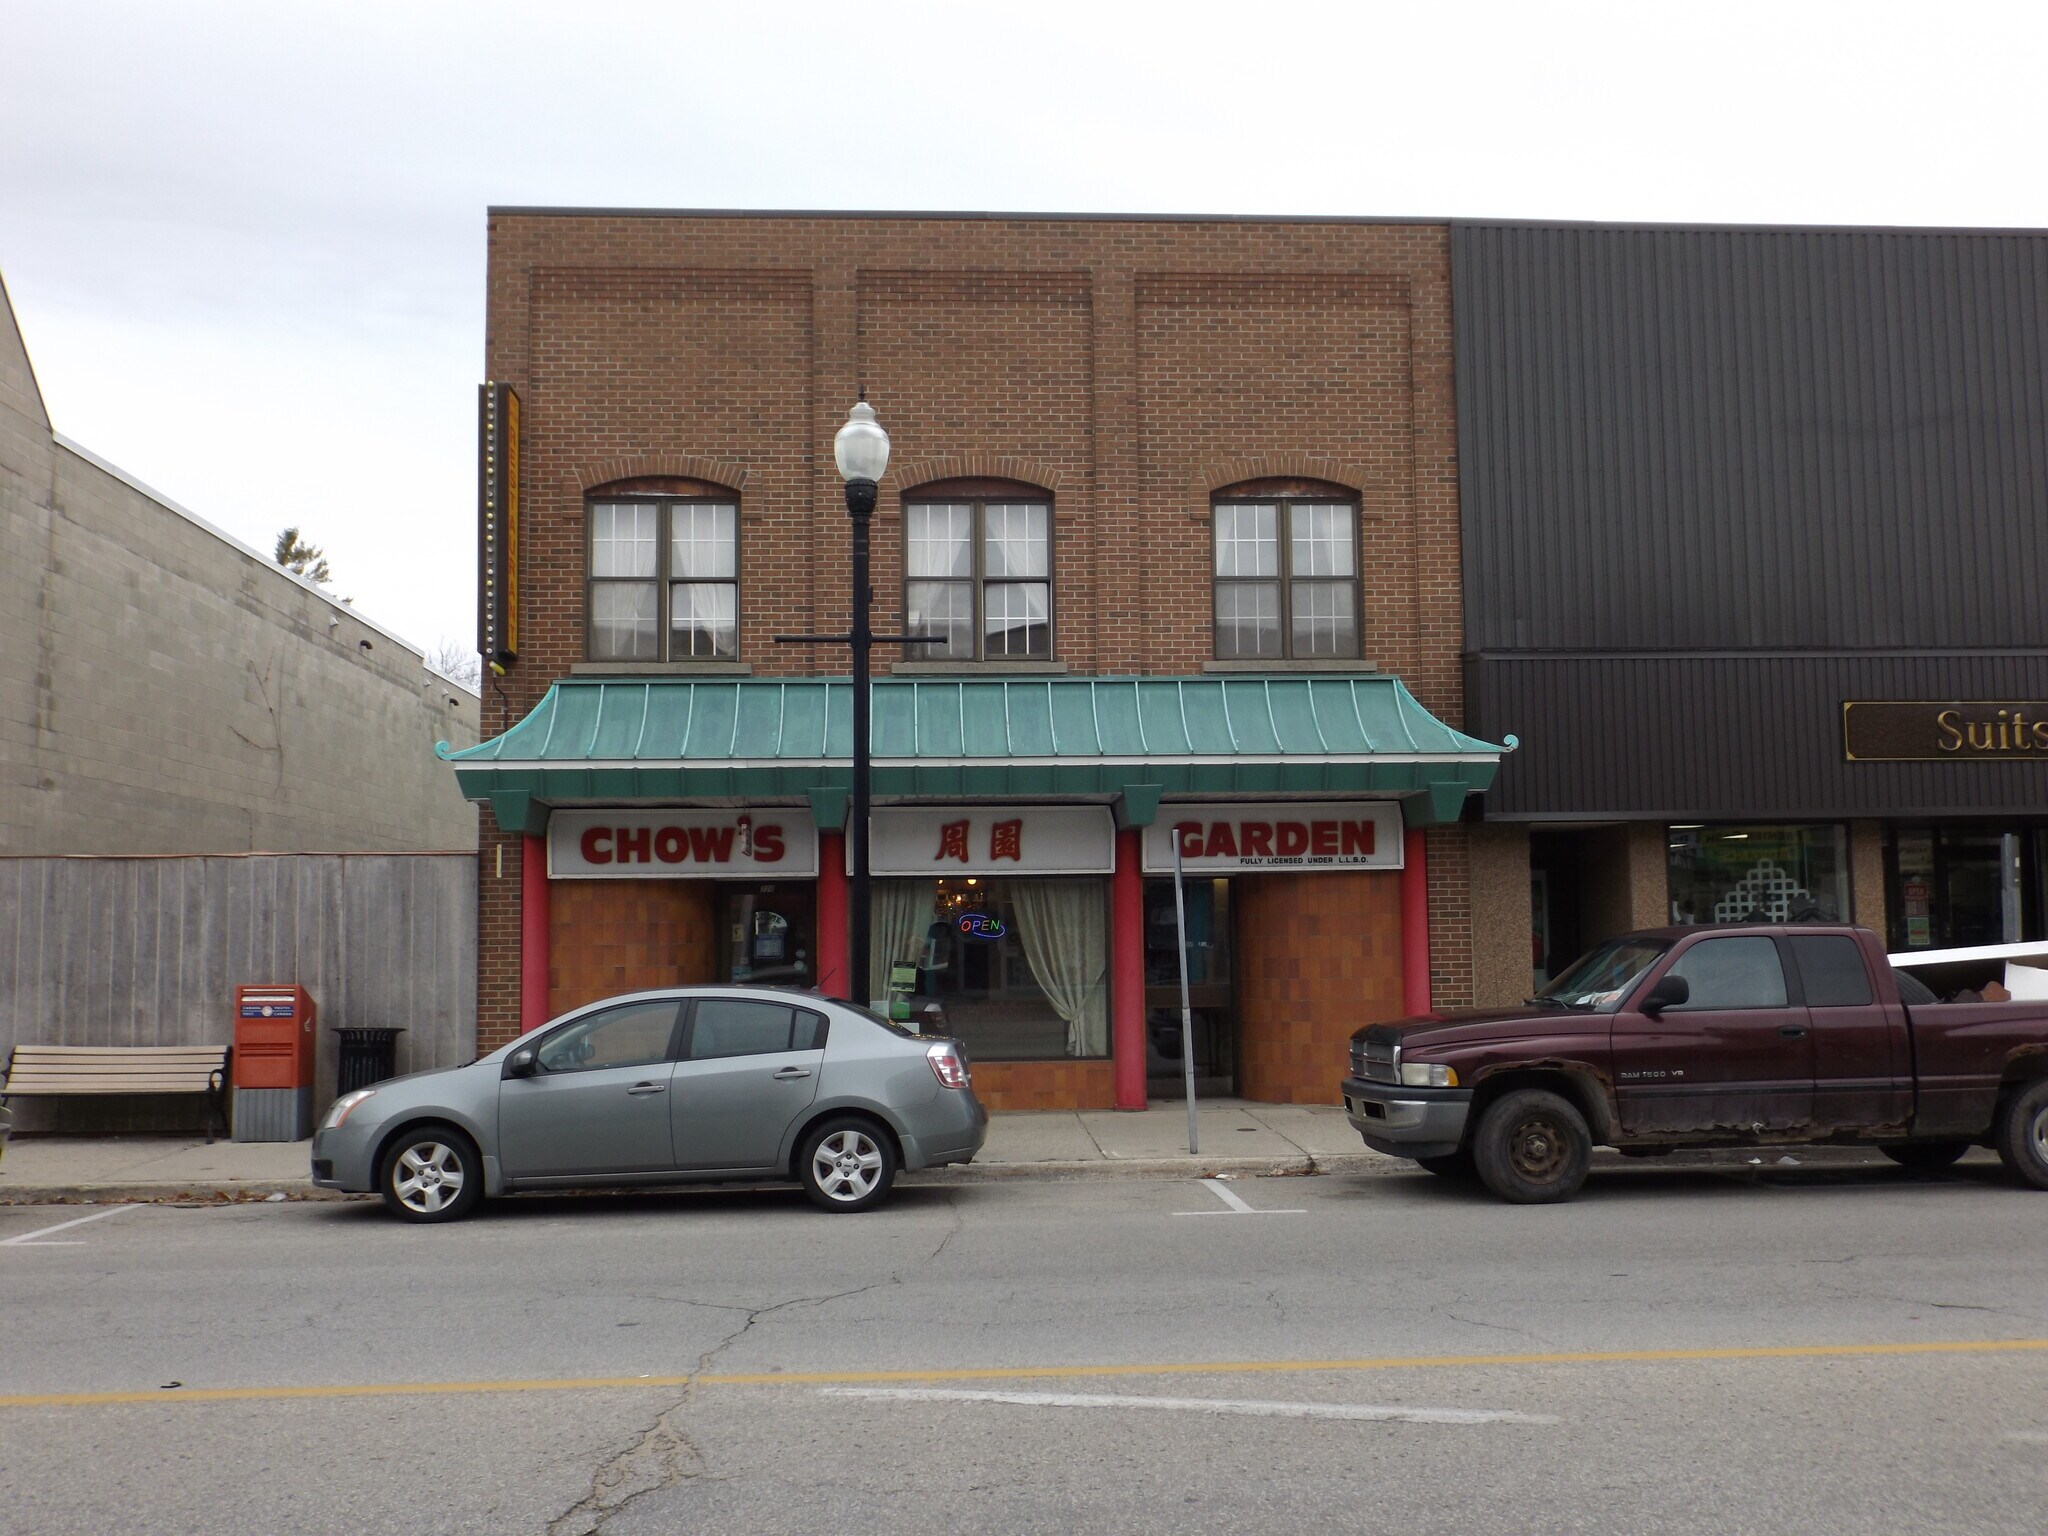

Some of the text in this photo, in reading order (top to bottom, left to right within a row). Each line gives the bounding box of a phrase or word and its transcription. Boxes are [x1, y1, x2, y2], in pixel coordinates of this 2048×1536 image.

[508, 424, 517, 642] RESTAURANT
[1937, 709, 2048, 751] Suits
[581, 815, 785, 865] CHOW'S
[1172, 820, 1375, 858] GARDEN
[1240, 857, 1263, 865] FULLY
[1307, 856, 1334, 864] UNDER
[960, 919, 1001, 932] OPEN
